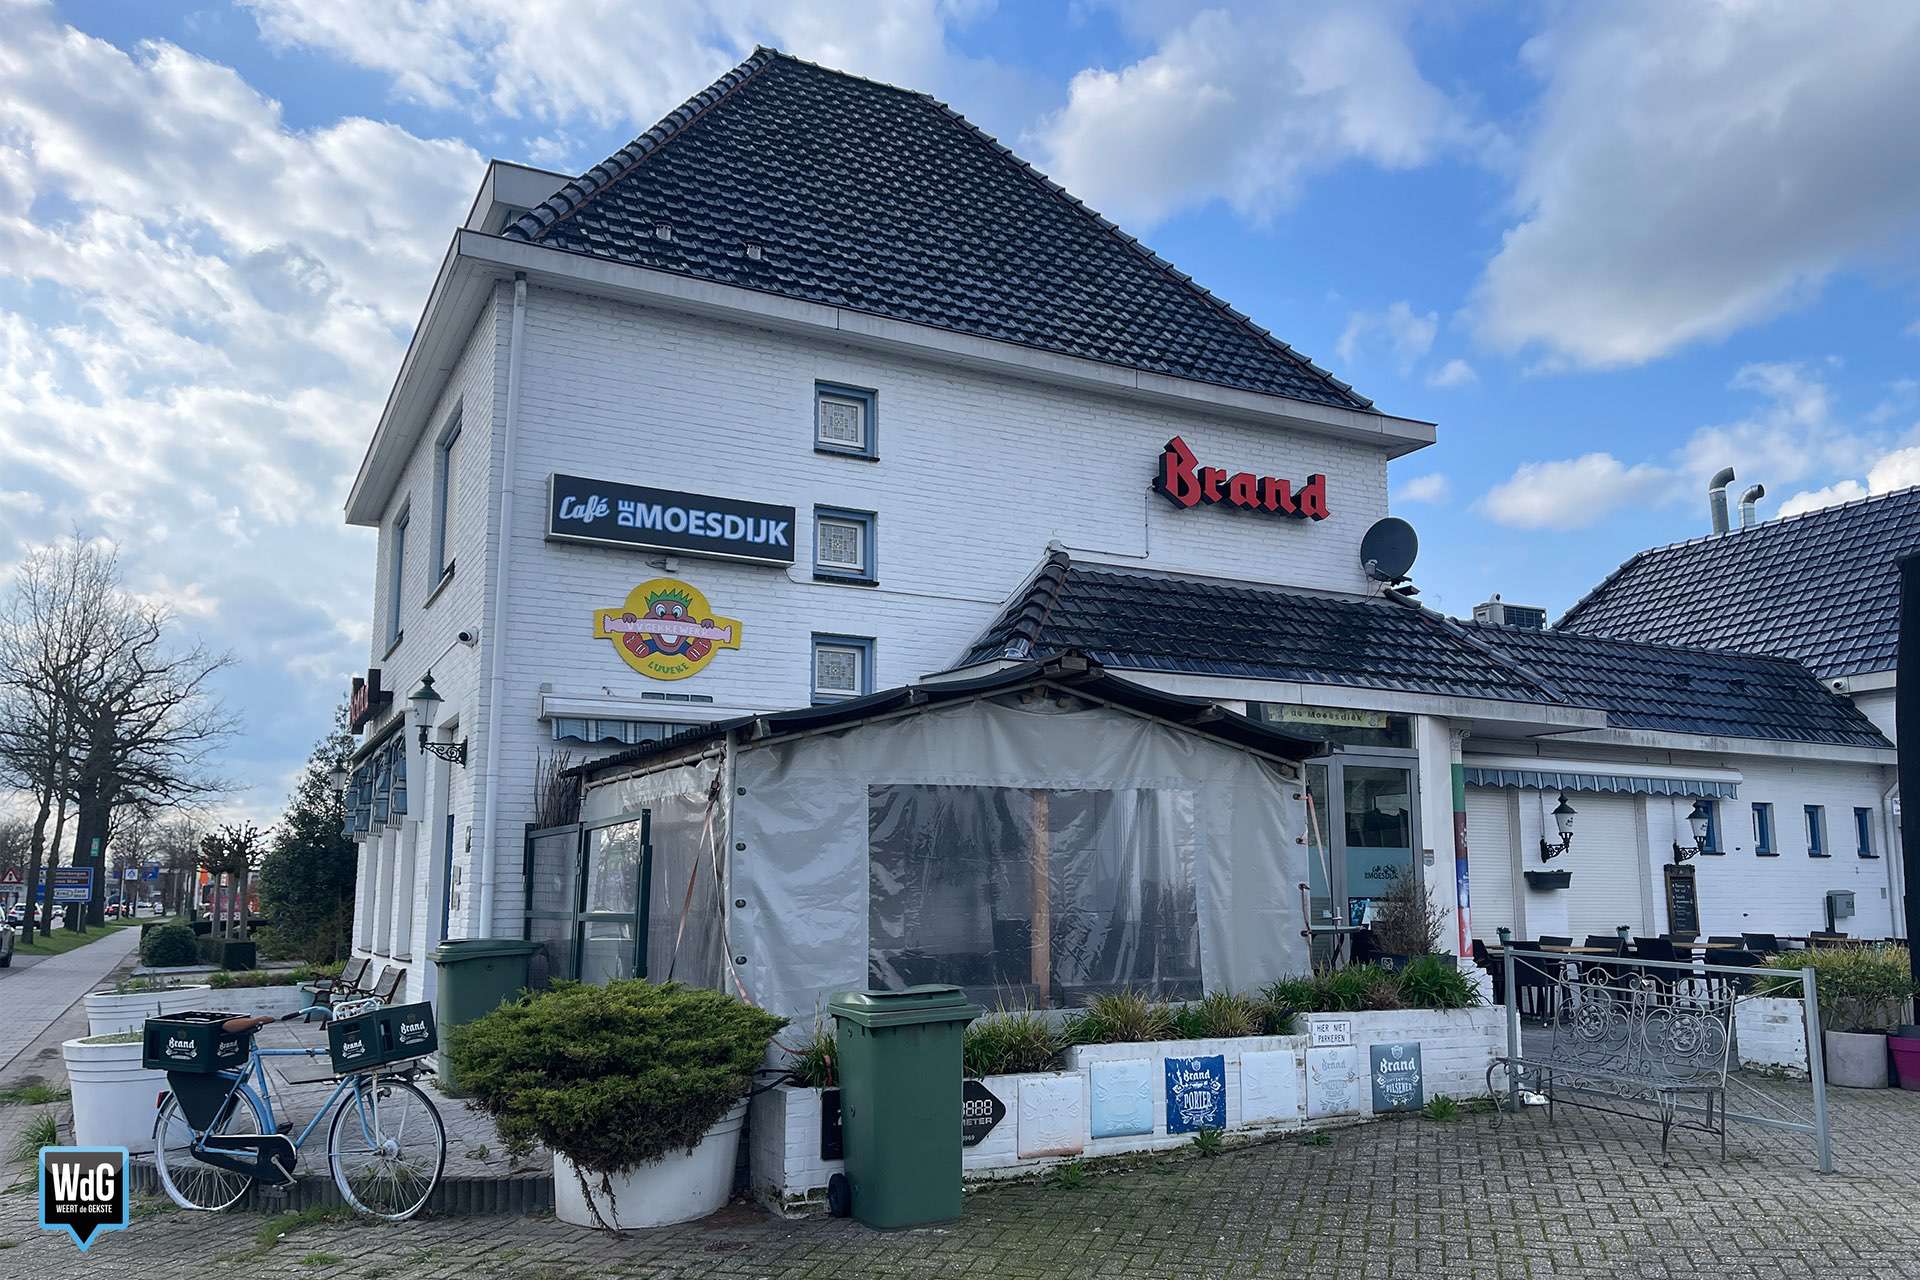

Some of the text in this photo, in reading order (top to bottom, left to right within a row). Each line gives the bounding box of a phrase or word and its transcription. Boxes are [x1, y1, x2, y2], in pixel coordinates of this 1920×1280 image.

[1159, 435, 1330, 521] Brand
[559, 494, 789, 546] Café DE MOESDIJK
[401, 1020, 425, 1034] Brand
[168, 1036, 195, 1049] Brand
[219, 1040, 238, 1051] Brand
[343, 1039, 363, 1051] Brand
[1318, 1034, 1345, 1043] PARKEREN
[1380, 1057, 1416, 1074] Brand
[1183, 1068, 1211, 1082] Brand
[1184, 1091, 1213, 1110] PORTER
[962, 1099, 993, 1117] 888
